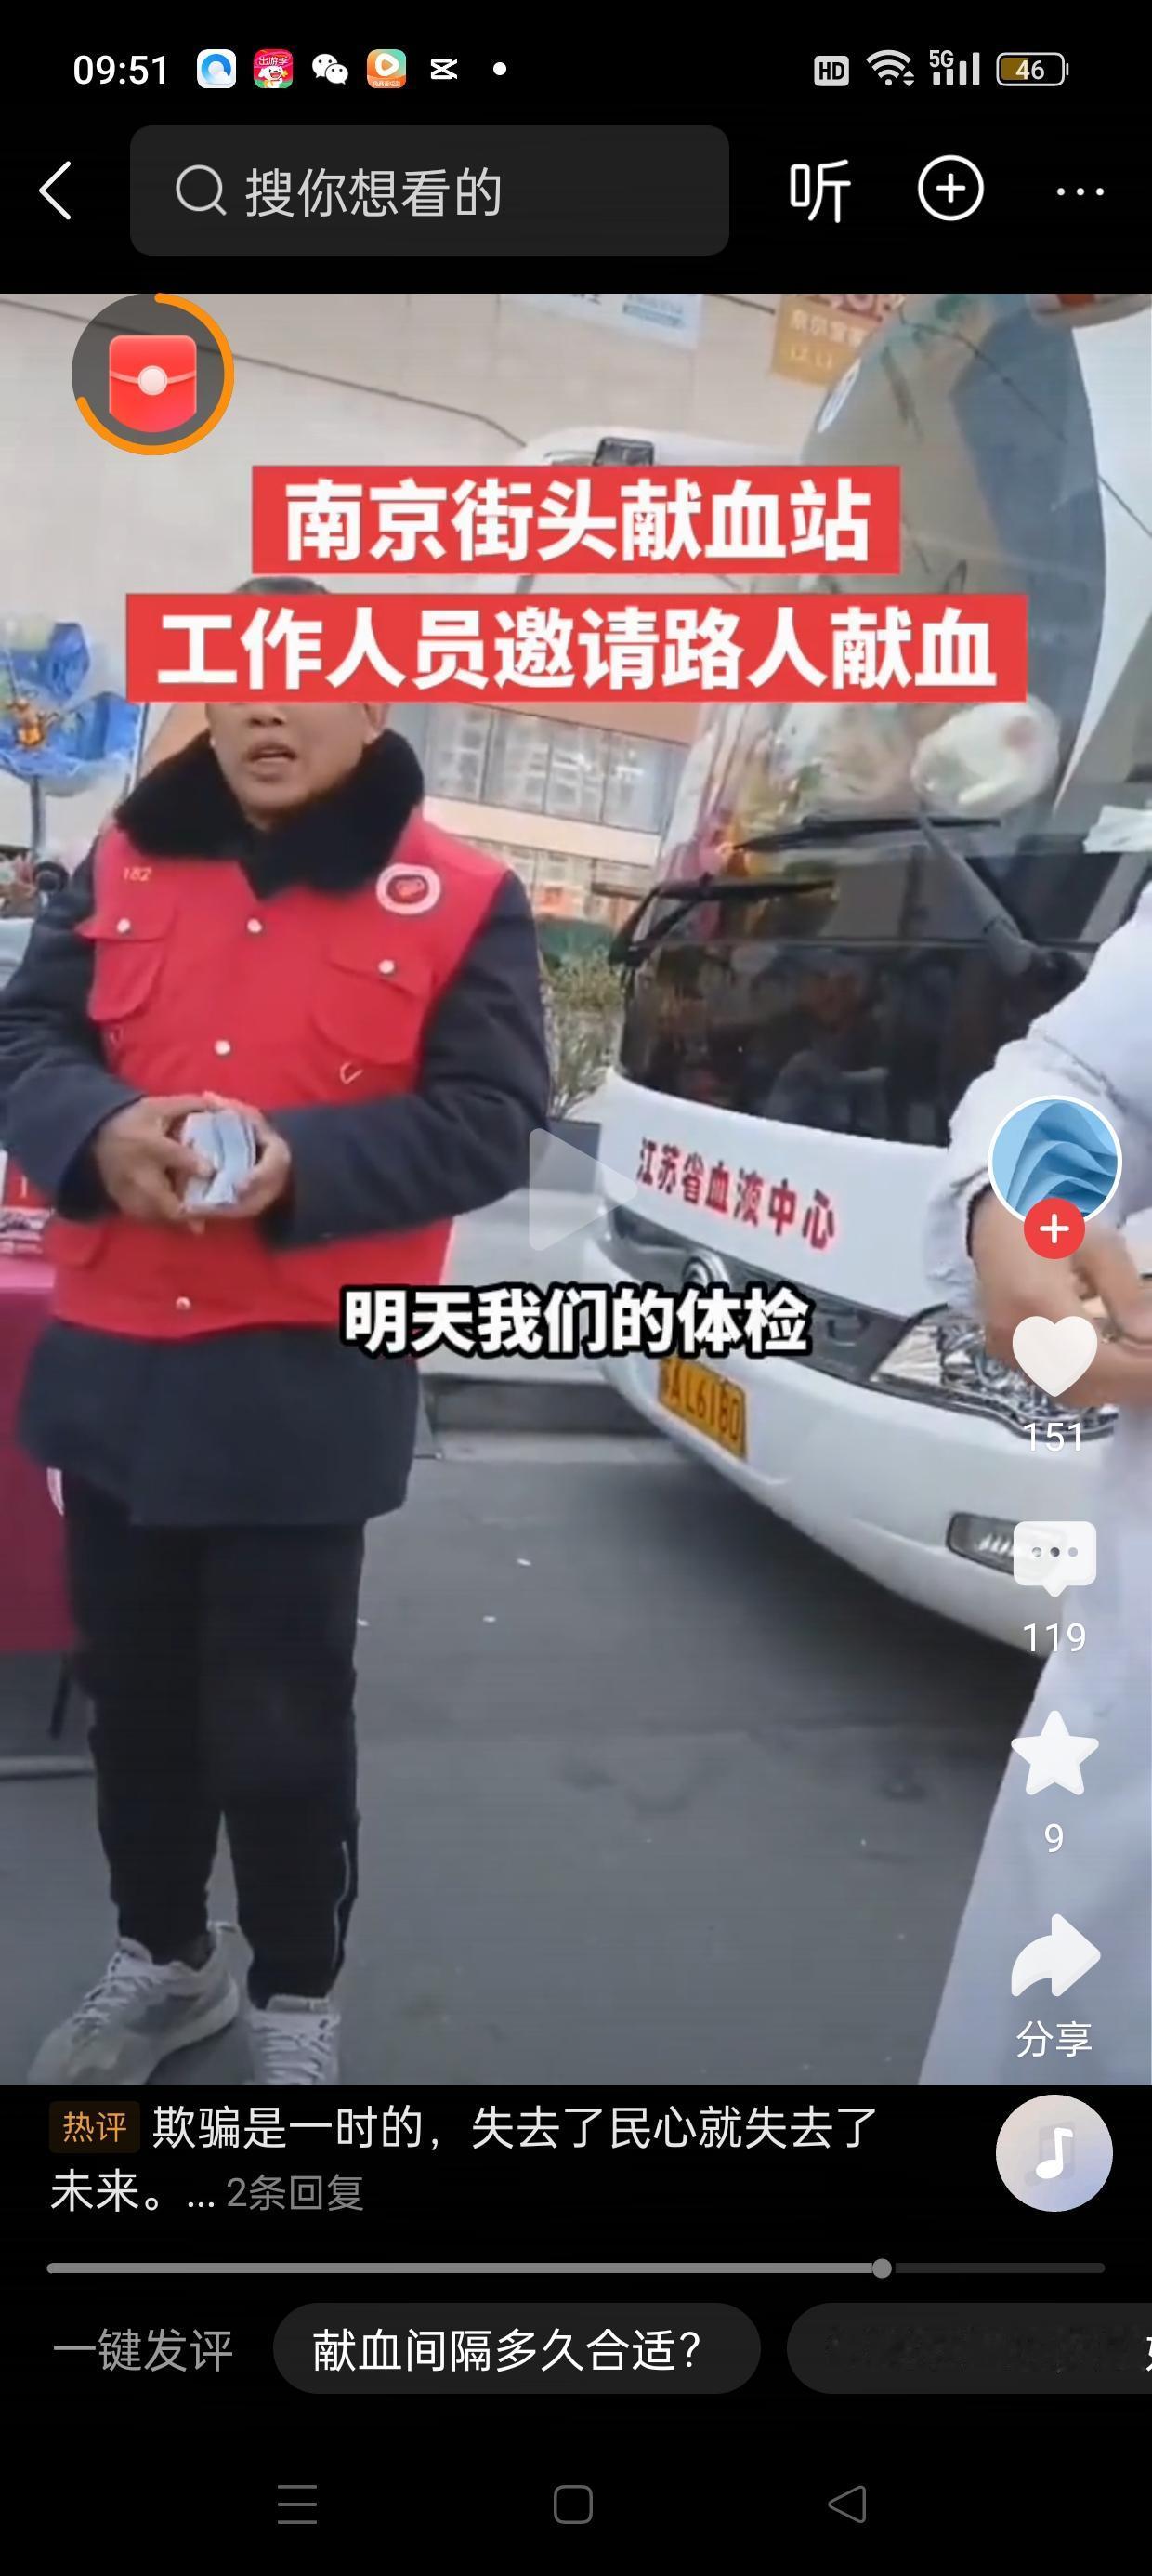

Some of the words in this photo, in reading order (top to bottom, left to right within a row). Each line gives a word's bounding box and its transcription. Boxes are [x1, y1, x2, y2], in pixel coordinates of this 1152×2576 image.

[74, 56, 165, 85] 09:51
[818, 61, 845, 80] HD
[929, 50, 954, 68] 5G
[1015, 59, 1045, 80] 46
[245, 167, 500, 217] 搜你想看的
[791, 160, 852, 224] 听
[635, 1136, 834, 1250] 江苏省血液中心
[1024, 1422, 1081, 1452] 151
[1024, 1623, 1086, 1653] 119
[1044, 1823, 1064, 1854] 9
[1016, 2020, 1093, 2057] 分享
[63, 2111, 127, 2143] 热评
[152, 2104, 876, 2151] 欺骗是一时的，失去了民心就失去了
[227, 2173, 364, 2212] 2条回复
[53, 2328, 233, 2372] 一键发评
